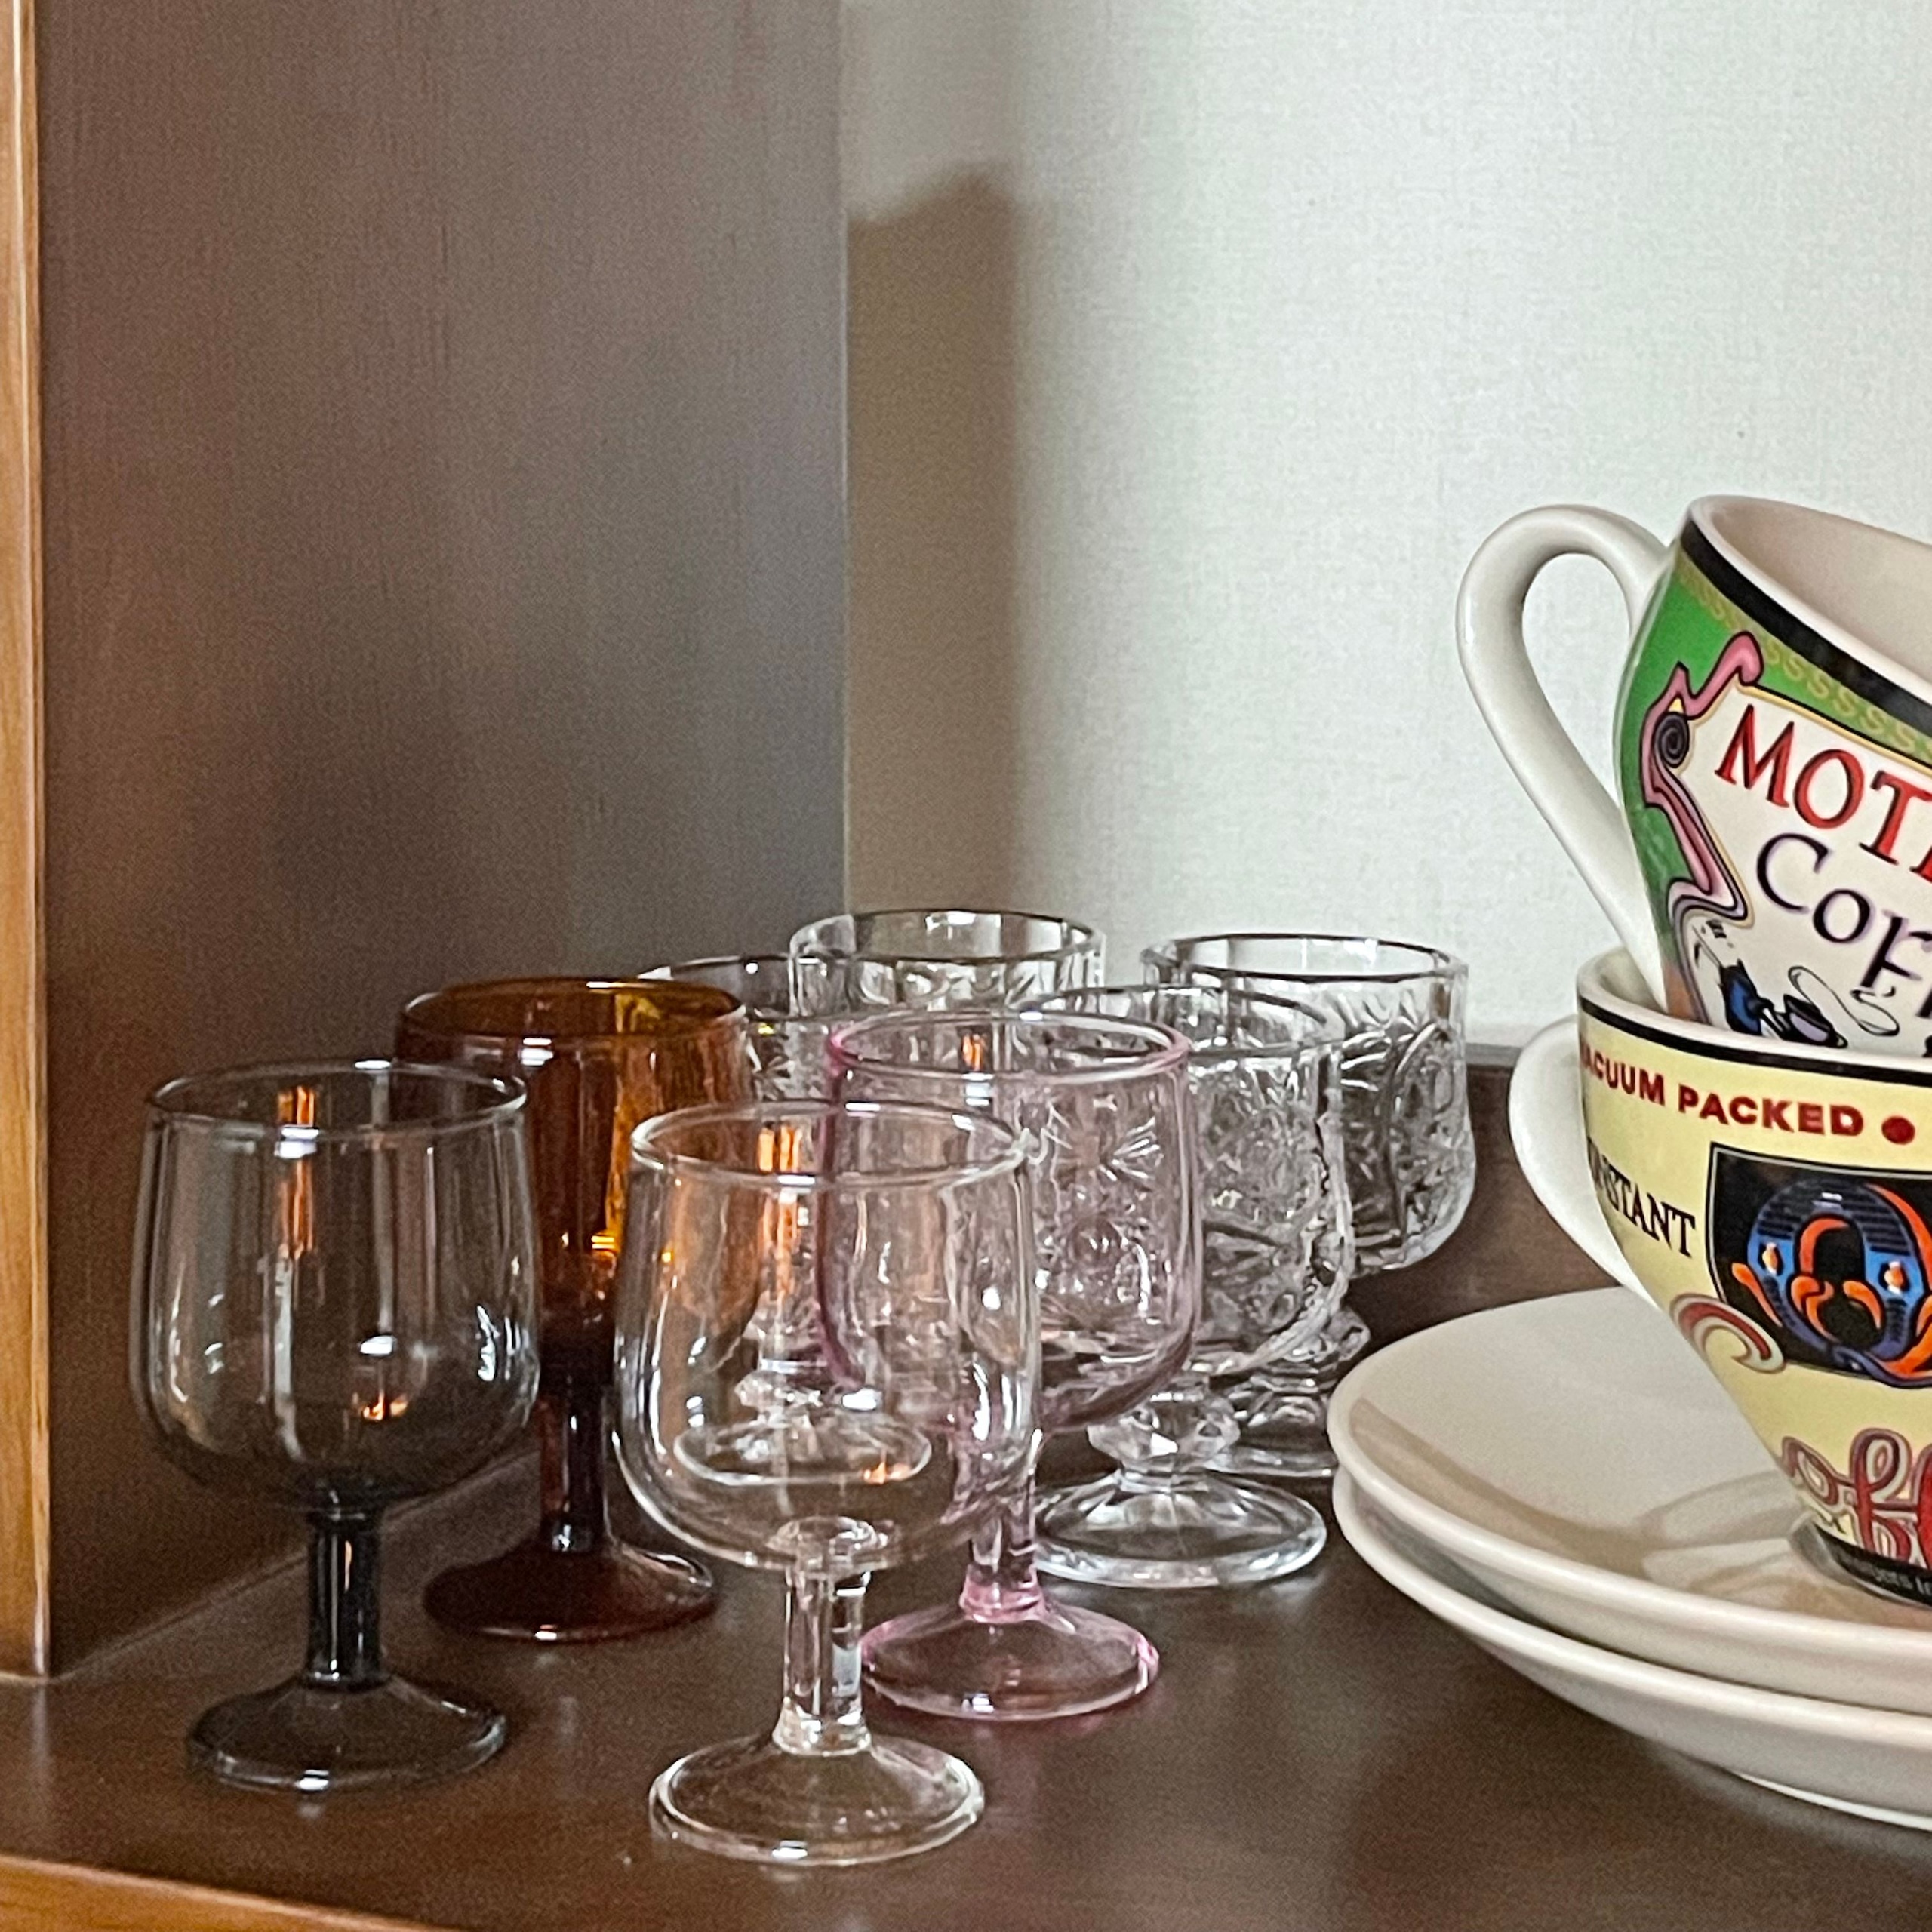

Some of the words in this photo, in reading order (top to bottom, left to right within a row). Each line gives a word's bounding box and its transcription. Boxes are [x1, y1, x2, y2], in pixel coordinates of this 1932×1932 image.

[1714, 703, 1932, 884] MOT
[1580, 1035, 1666, 1107] ACUUM
[1678, 1083, 1864, 1137] PACKED
